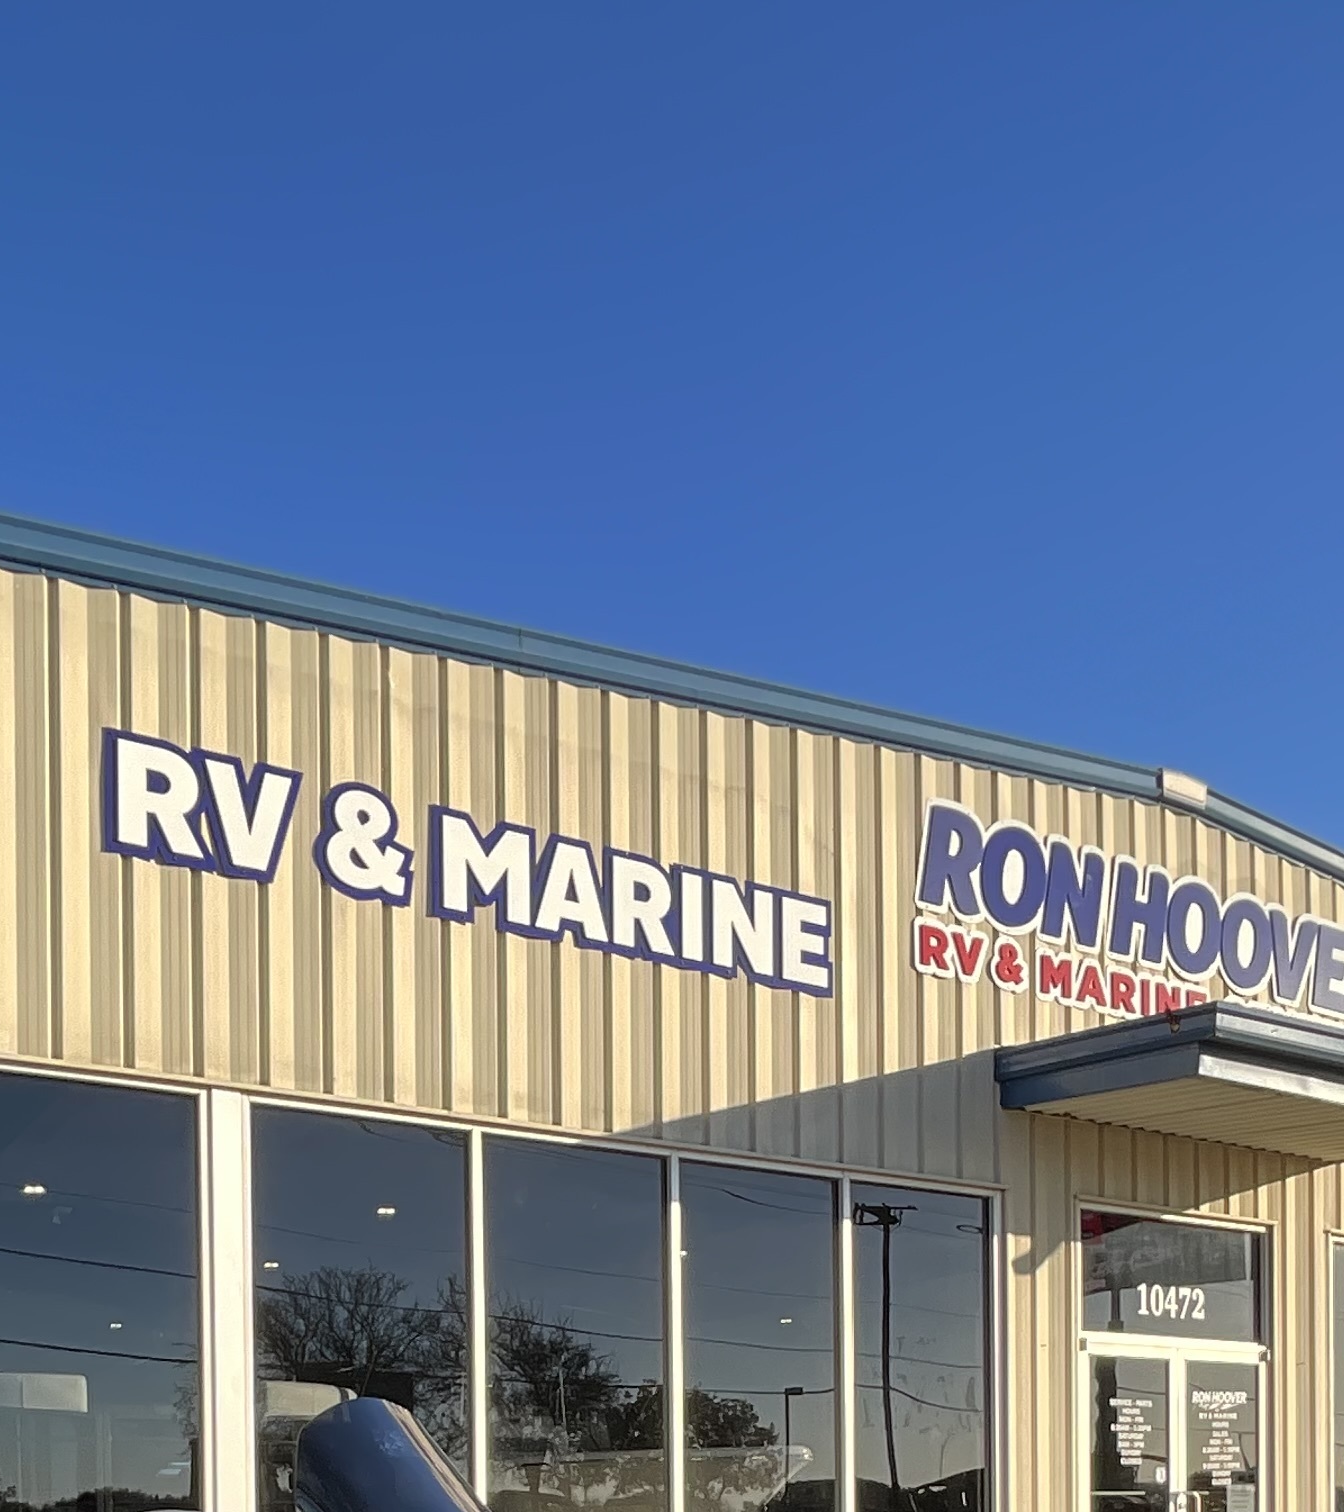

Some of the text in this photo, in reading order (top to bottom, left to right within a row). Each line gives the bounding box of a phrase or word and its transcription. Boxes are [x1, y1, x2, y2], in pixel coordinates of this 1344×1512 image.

[103, 729, 831, 996] RV & MARINE
[919, 801, 1105, 950] RON
[918, 923, 984, 978] RV
[995, 940, 1024, 984] &
[1136, 1283, 1205, 1320] 10472
